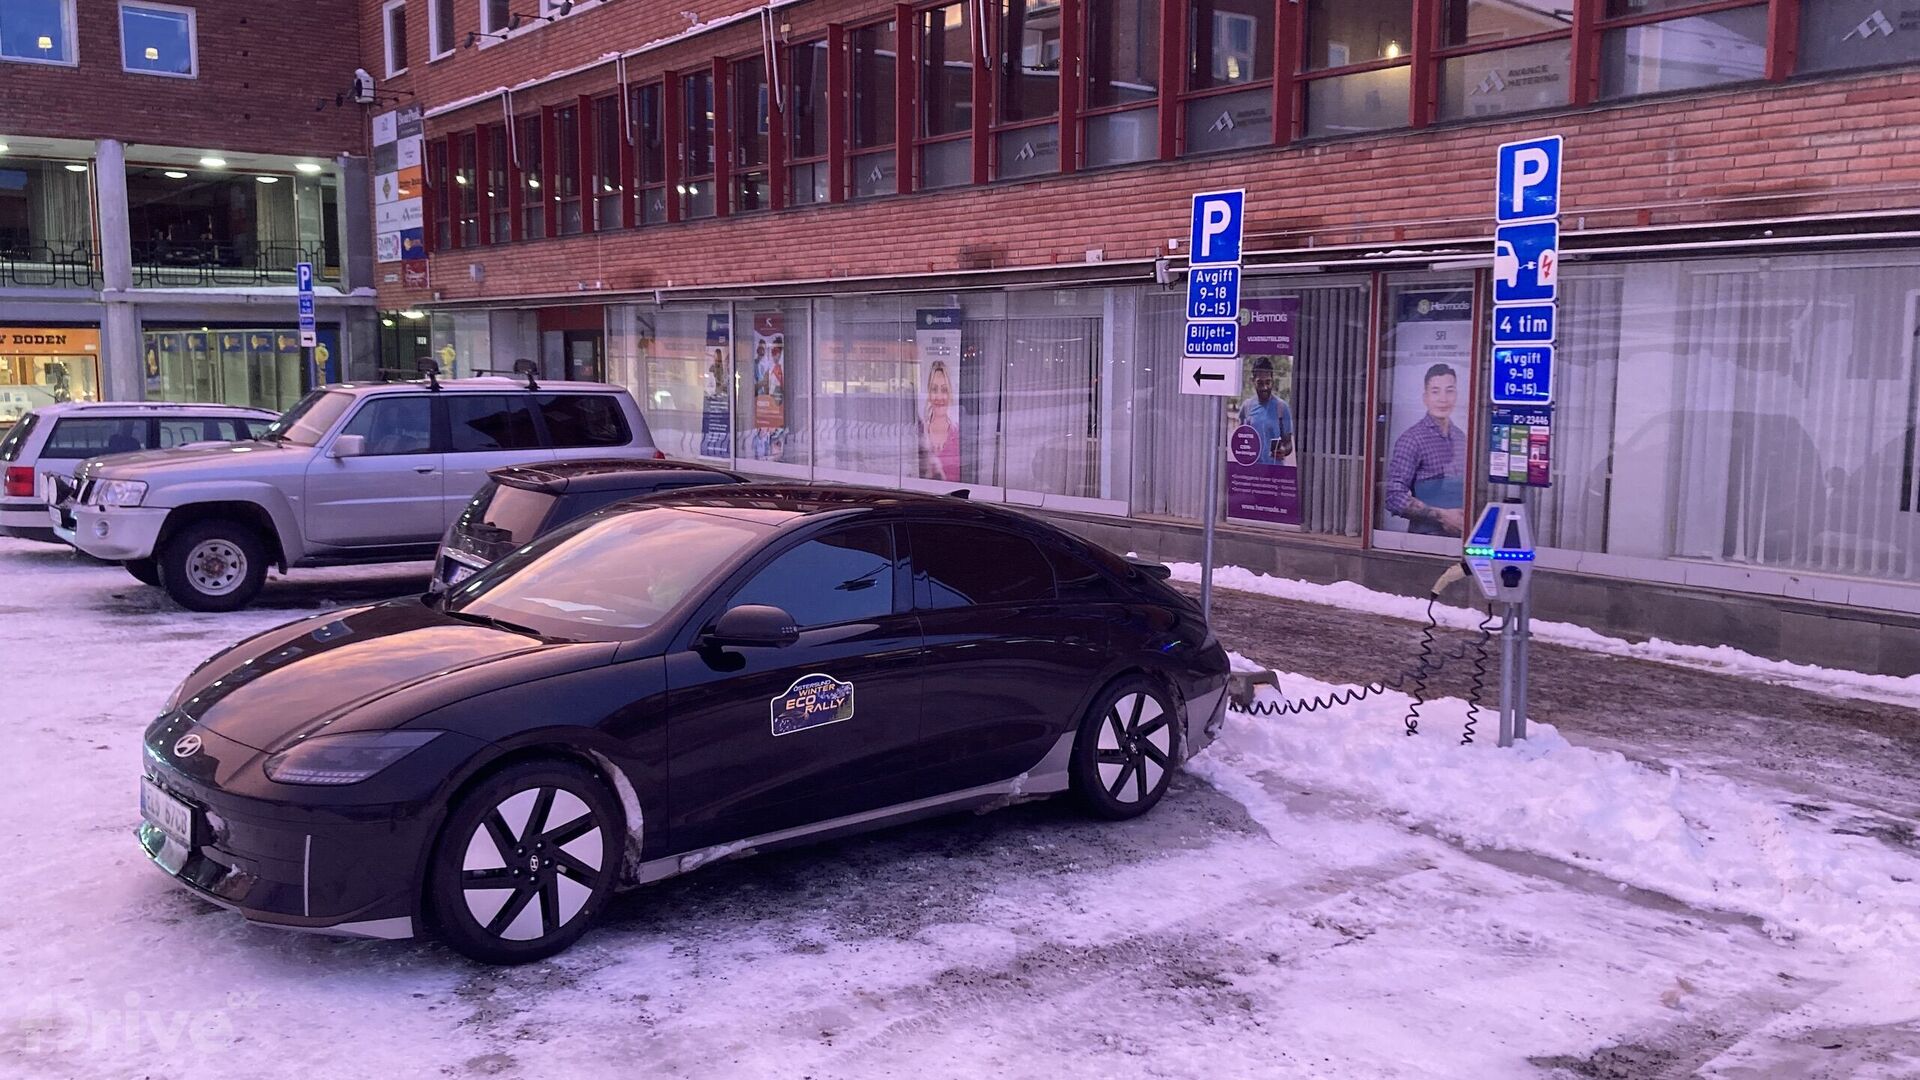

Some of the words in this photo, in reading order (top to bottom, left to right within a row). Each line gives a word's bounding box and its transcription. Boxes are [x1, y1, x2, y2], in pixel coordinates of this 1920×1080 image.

[1508, 64, 1549, 77] AVANCE
[1507, 73, 1560, 87] METERING
[1512, 148, 1550, 213] P
[1201, 200, 1232, 257] P
[300, 266, 310, 290] P
[1196, 269, 1233, 286] Avgift
[1199, 286, 1227, 300] 9-18
[1194, 301, 1231, 316] (9-15)
[1430, 300, 1470, 311] Hermods
[1251, 311, 1288, 322] Hermods
[1499, 315, 1512, 333] 4
[1518, 314, 1548, 333] tim
[12, 334, 67, 345] BODEN
[1190, 325, 1232, 341] Biljett-
[1187, 340, 1234, 353] automat
[1503, 351, 1542, 368] Avgift
[1509, 368, 1535, 380] 9-18
[1504, 382, 1538, 396] (9-15)
[1526, 415, 1549, 426] 23446
[793, 680, 831, 692] ÖSTERSUND
[799, 684, 836, 697] WINTER
[786, 695, 816, 710] ECO
[804, 698, 845, 714] RALLY
